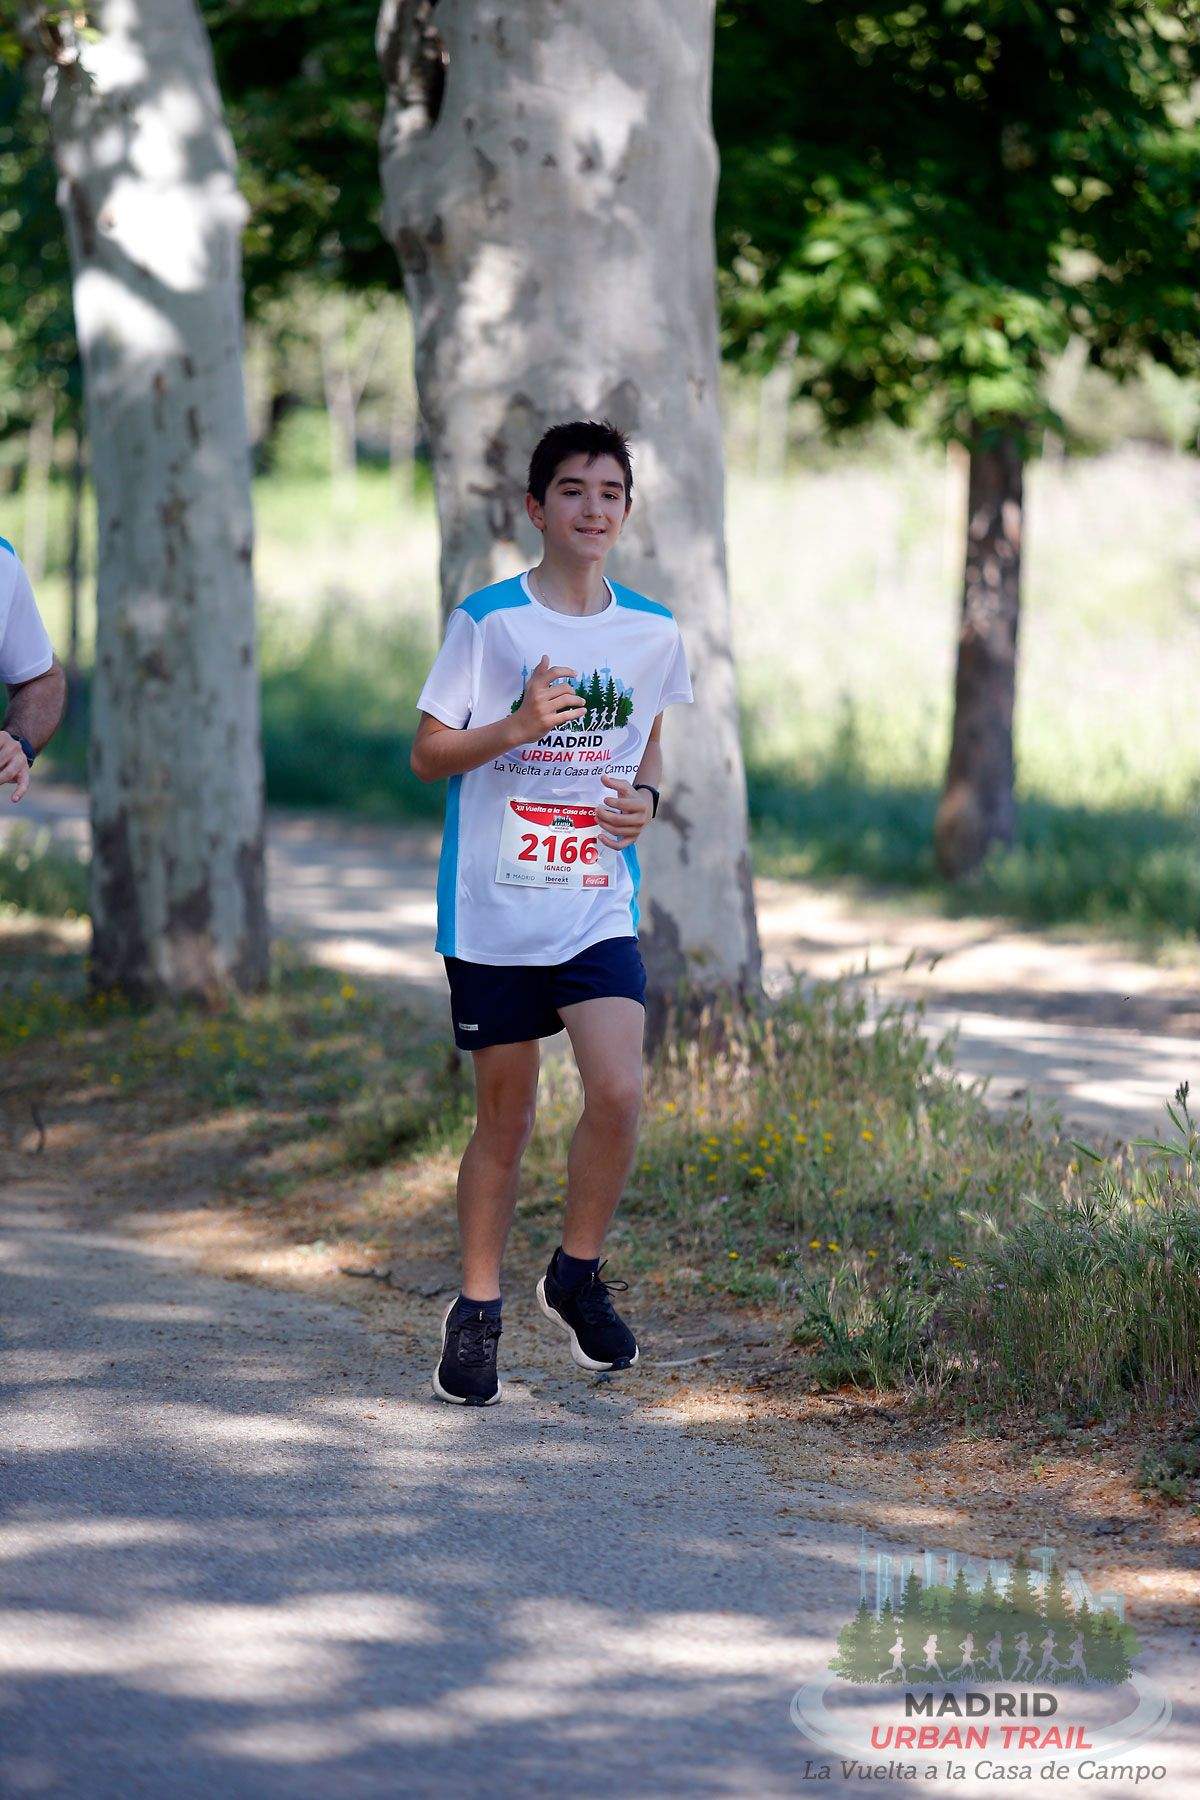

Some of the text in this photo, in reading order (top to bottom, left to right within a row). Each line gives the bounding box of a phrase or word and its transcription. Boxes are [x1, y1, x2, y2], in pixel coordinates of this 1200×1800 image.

[537, 735, 603, 748] MADRID
[521, 749, 611, 762] URBAN TRAIL
[494, 760, 504, 771] La
[508, 763, 540, 776] Vuelta
[552, 766, 561, 776] la
[564, 766, 589, 776] Casa
[591, 766, 603, 775] de
[604, 764, 639, 774] Campo
[525, 805, 547, 813] Vuelta
[518, 833, 599, 865] 2166
